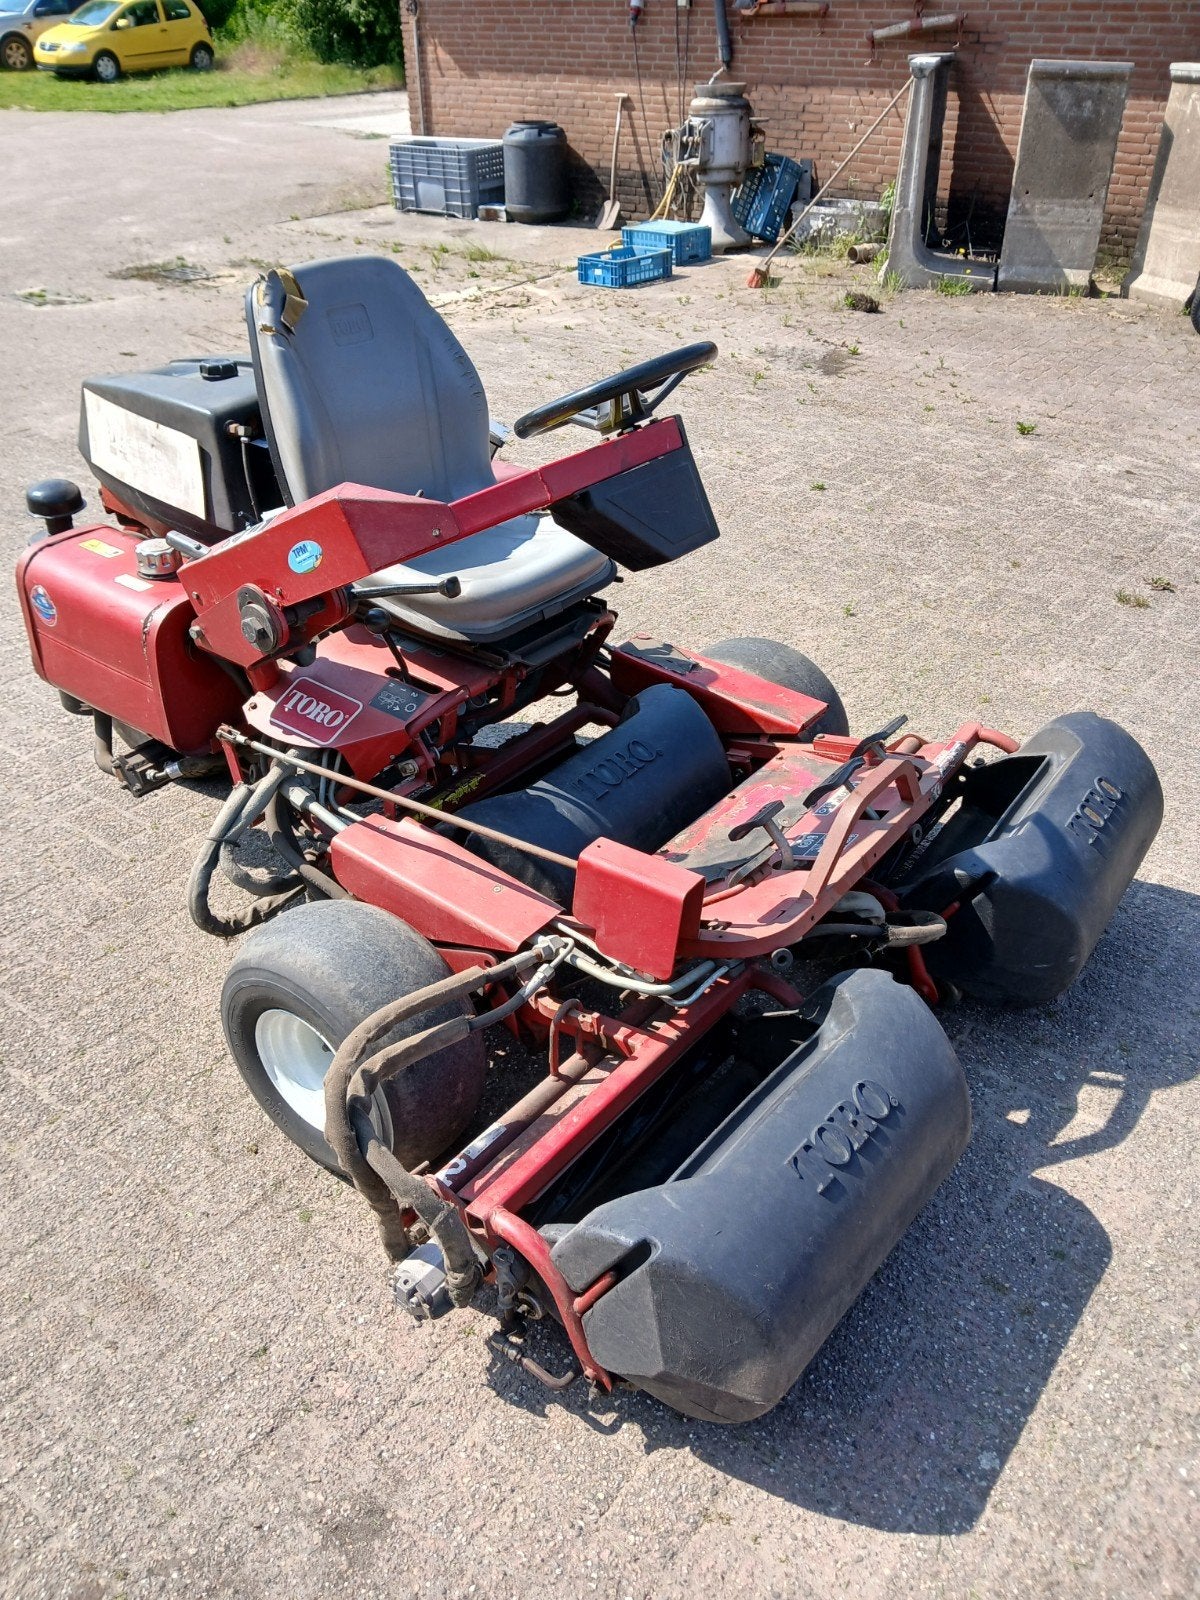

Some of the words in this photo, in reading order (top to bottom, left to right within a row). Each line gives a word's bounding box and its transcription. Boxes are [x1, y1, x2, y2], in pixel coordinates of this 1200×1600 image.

[283, 689, 344, 727] TORO
[571, 739, 658, 801] TORO
[1064, 776, 1121, 845] TORO
[783, 1079, 892, 1194] TORO
